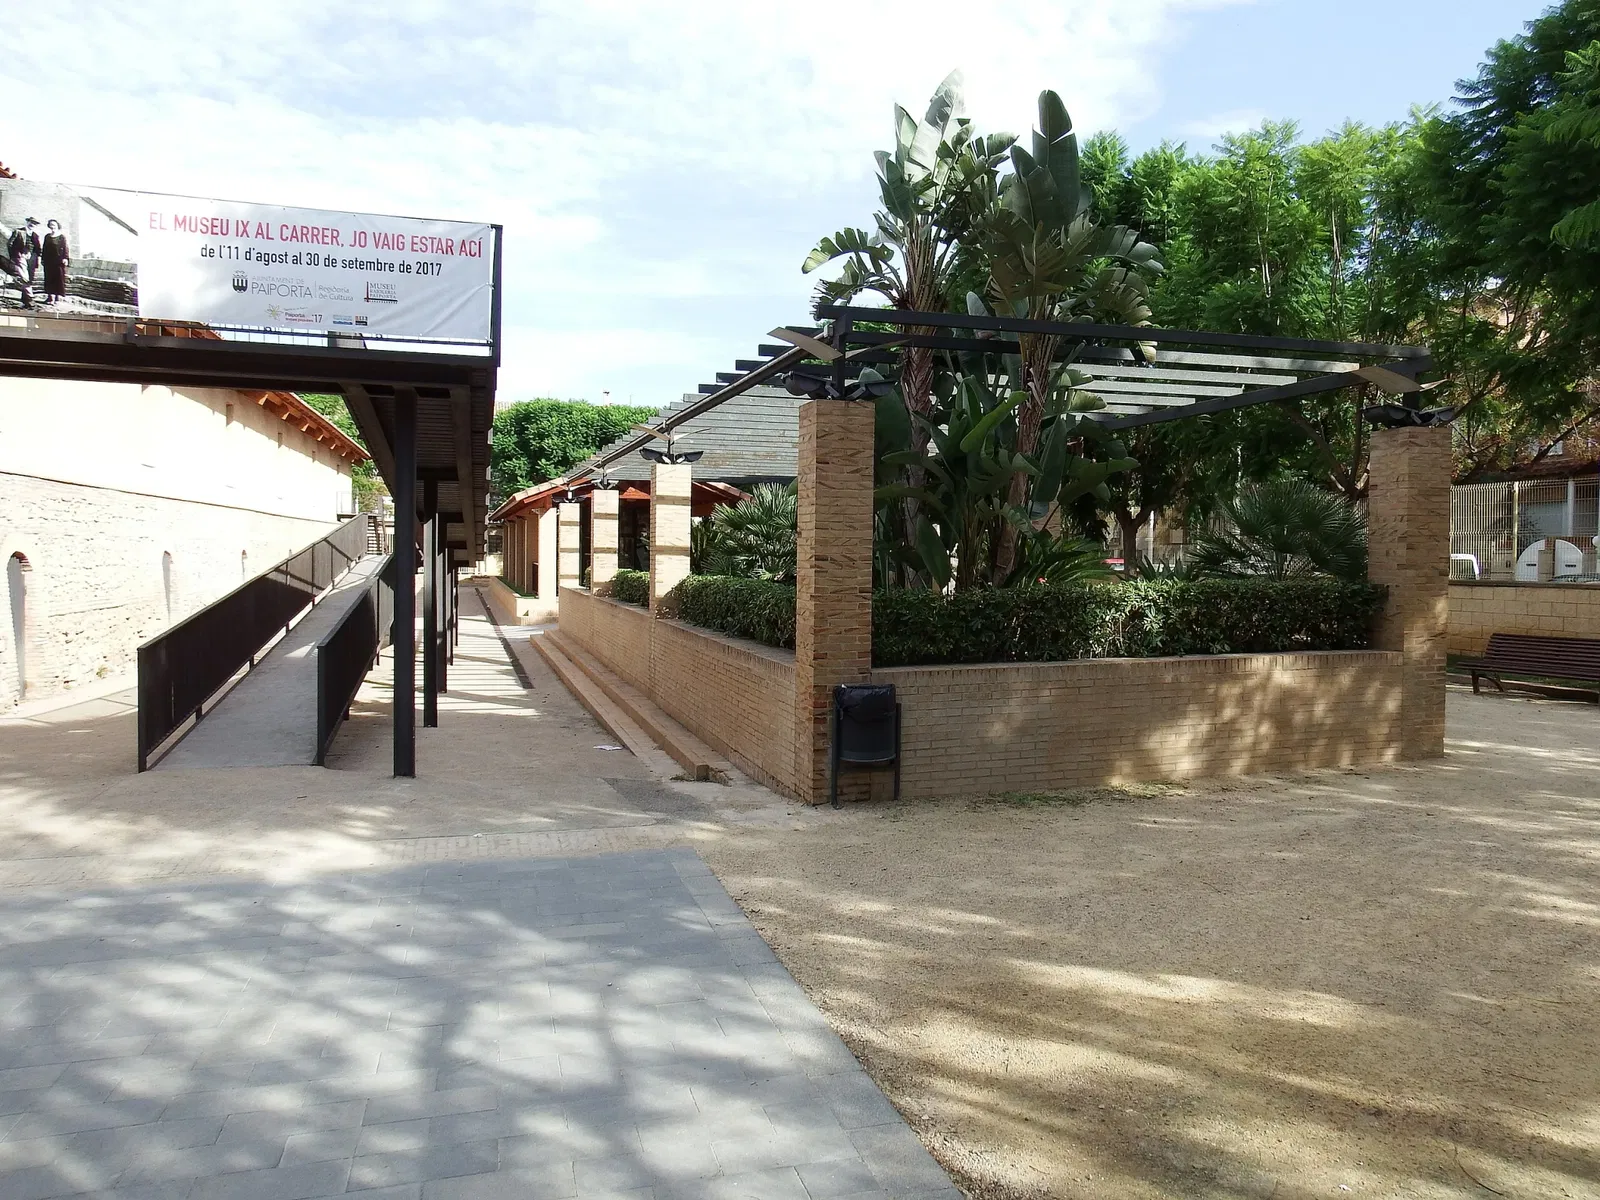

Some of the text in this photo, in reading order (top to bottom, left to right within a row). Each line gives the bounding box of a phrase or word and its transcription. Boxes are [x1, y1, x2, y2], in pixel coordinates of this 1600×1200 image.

[149, 211, 483, 258] EL MUSEU IX AL CARRER, JO VAIG ESTAR ACÍ
[200, 244, 442, 276] de l'11 d'agost al 30 de setembre de 2017
[251, 275, 294, 284] AJUNTAMENT
[369, 282, 396, 290] MUSEU
[251, 281, 313, 298] PAIPORTA
[318, 291, 354, 301] de Cultura
